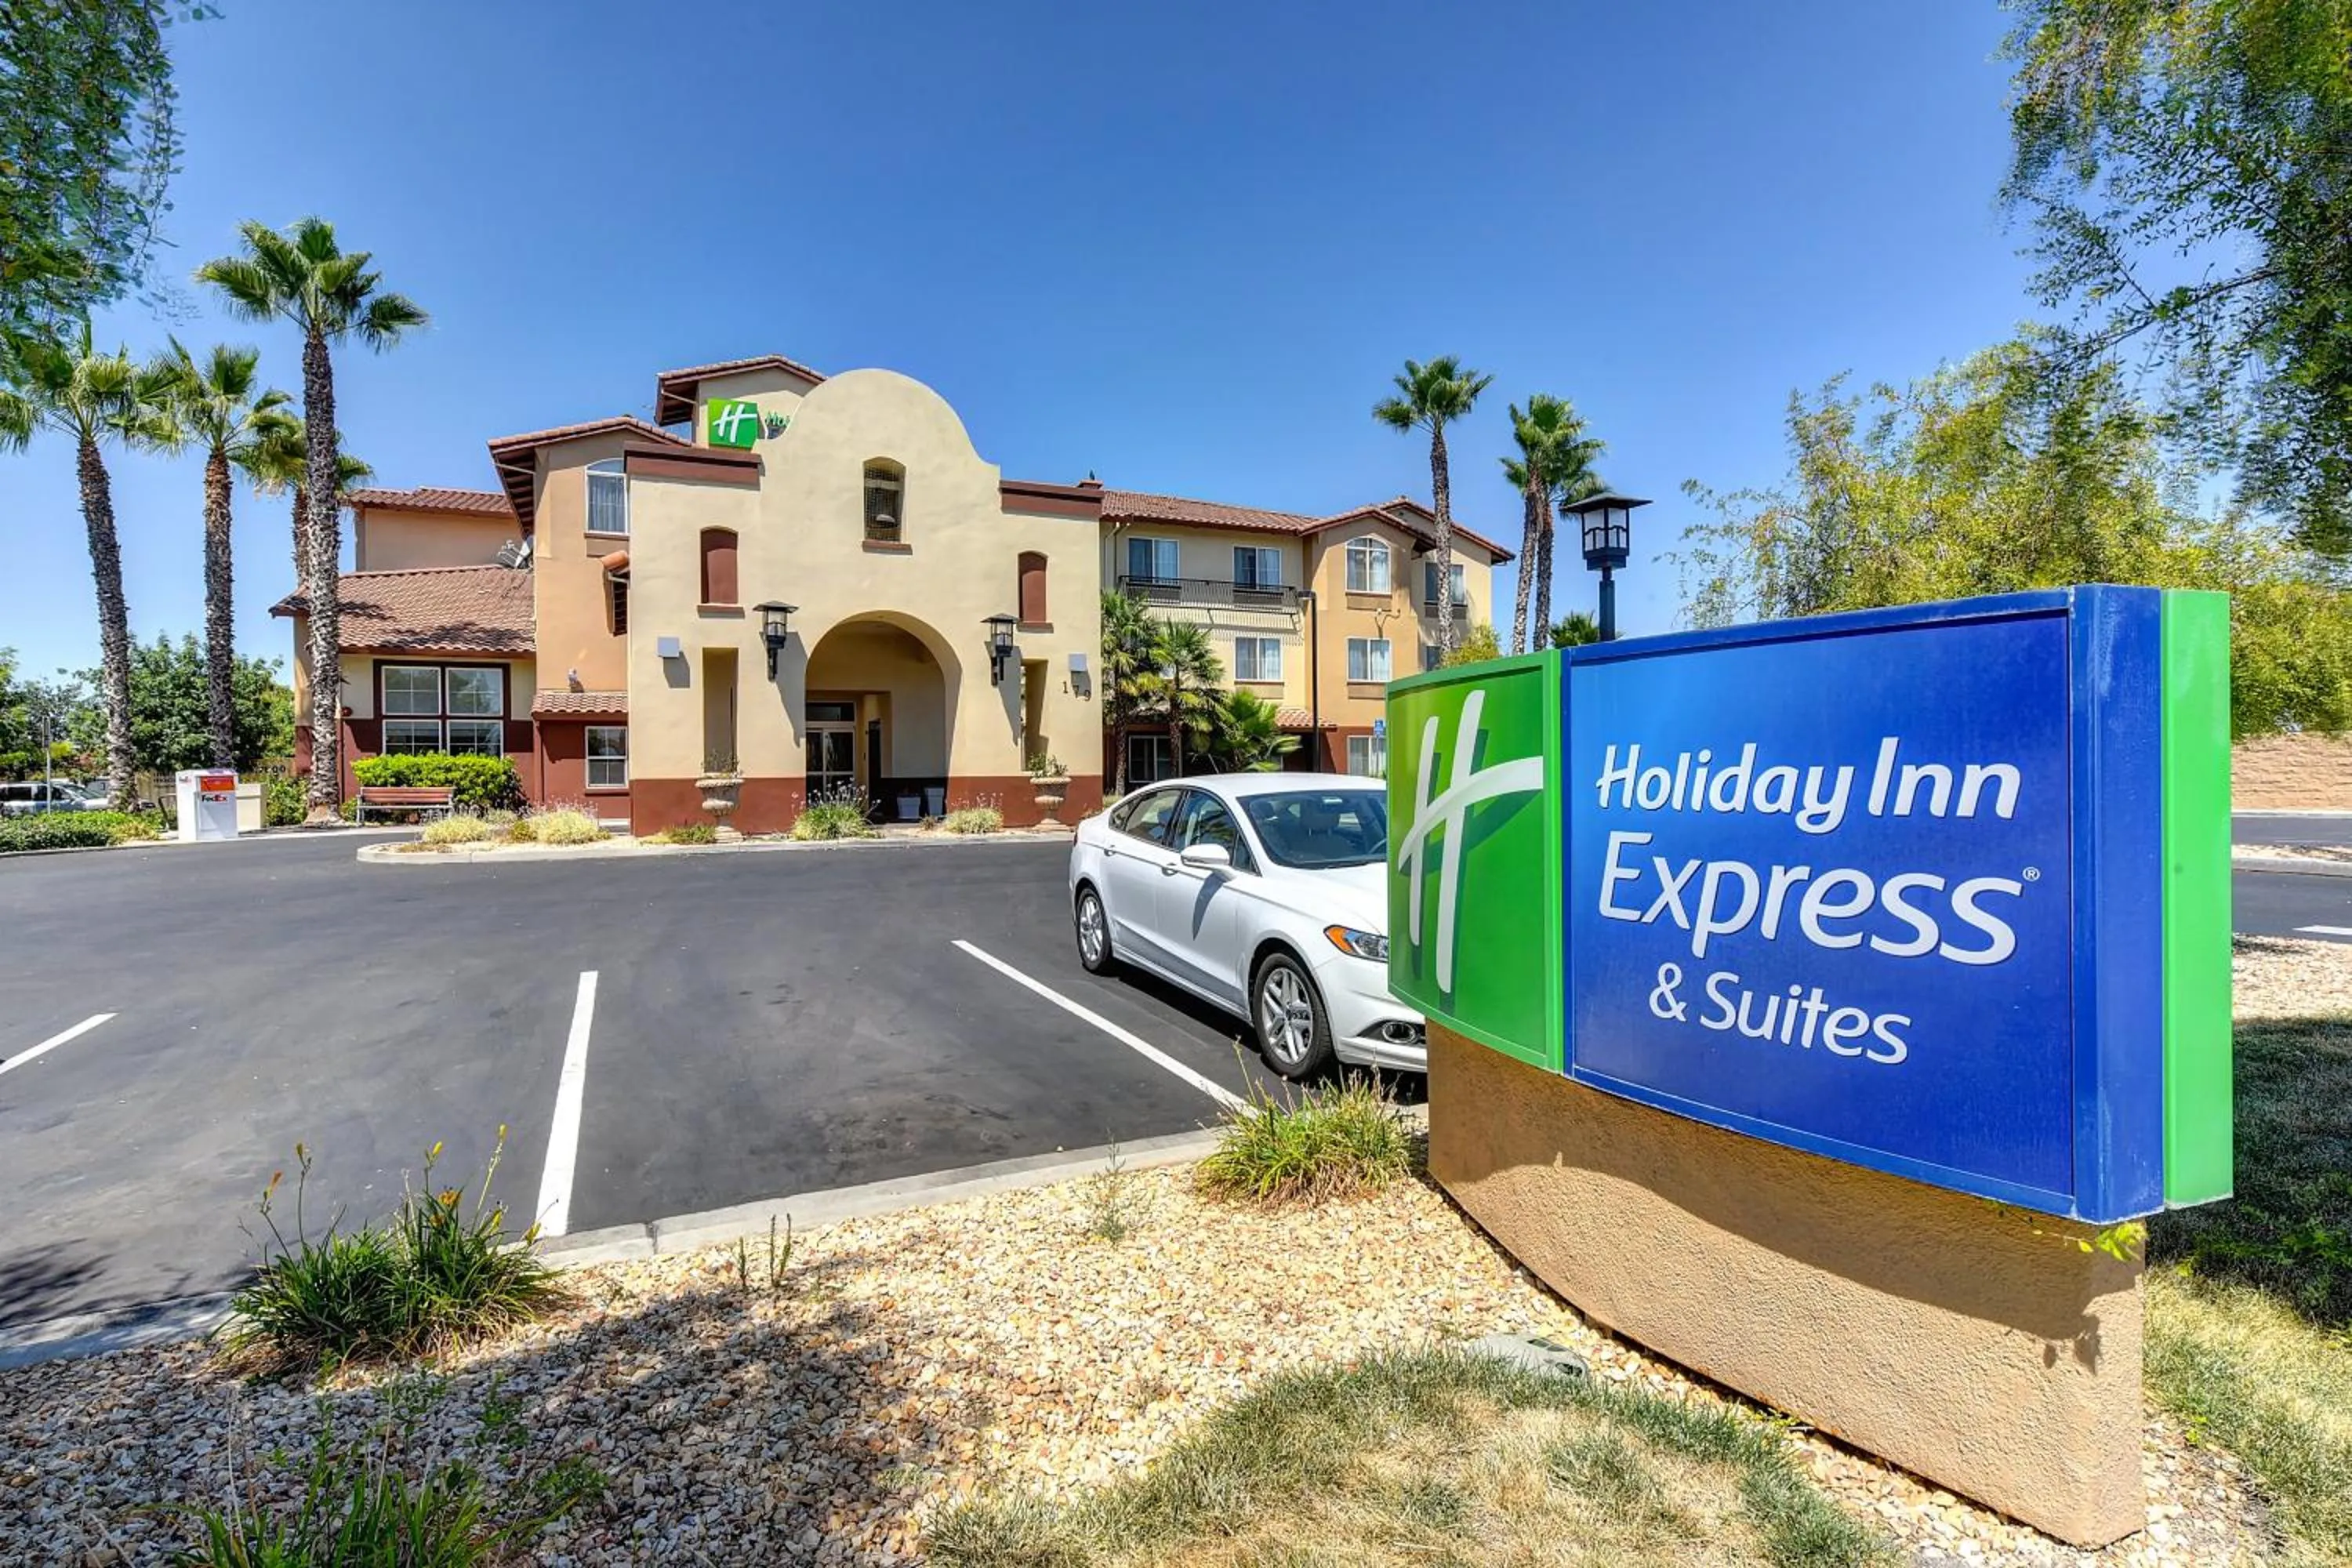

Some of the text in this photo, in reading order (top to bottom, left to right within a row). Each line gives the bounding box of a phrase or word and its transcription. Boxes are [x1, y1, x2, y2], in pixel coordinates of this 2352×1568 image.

[1595, 737, 2021, 834] Holiday Inn
[1649, 962, 1911, 1065] & Suites
